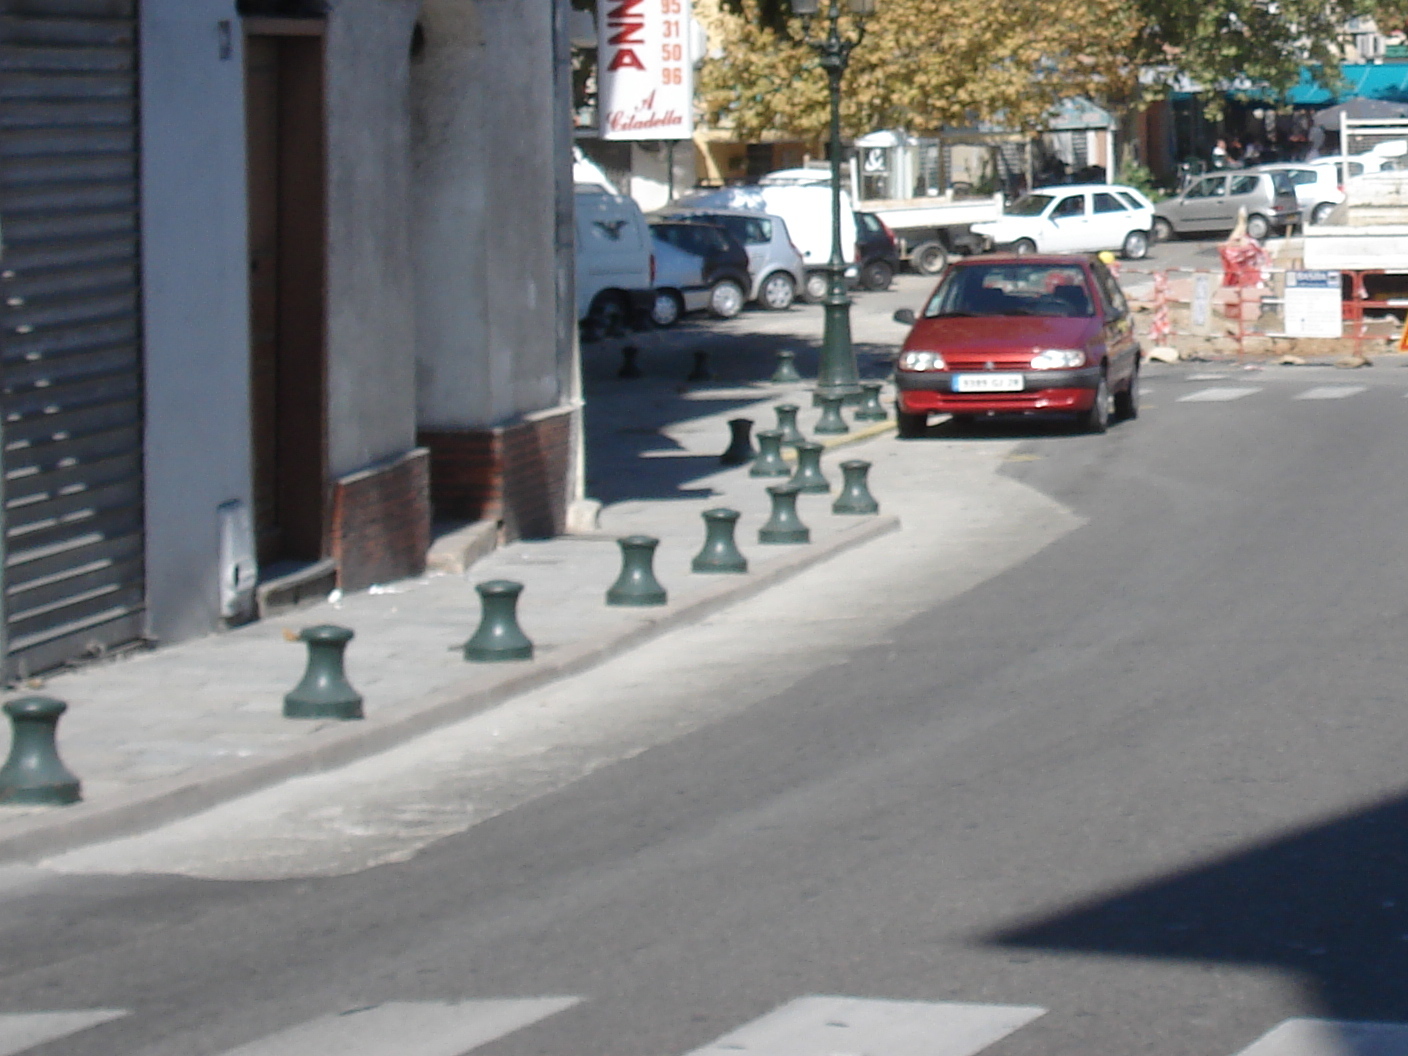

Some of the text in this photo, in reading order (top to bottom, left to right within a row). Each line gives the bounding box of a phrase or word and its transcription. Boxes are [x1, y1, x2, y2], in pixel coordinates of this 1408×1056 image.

[662, 20, 680, 38] 31
[661, 43, 682, 62] 50
[661, 67, 682, 86] 96
